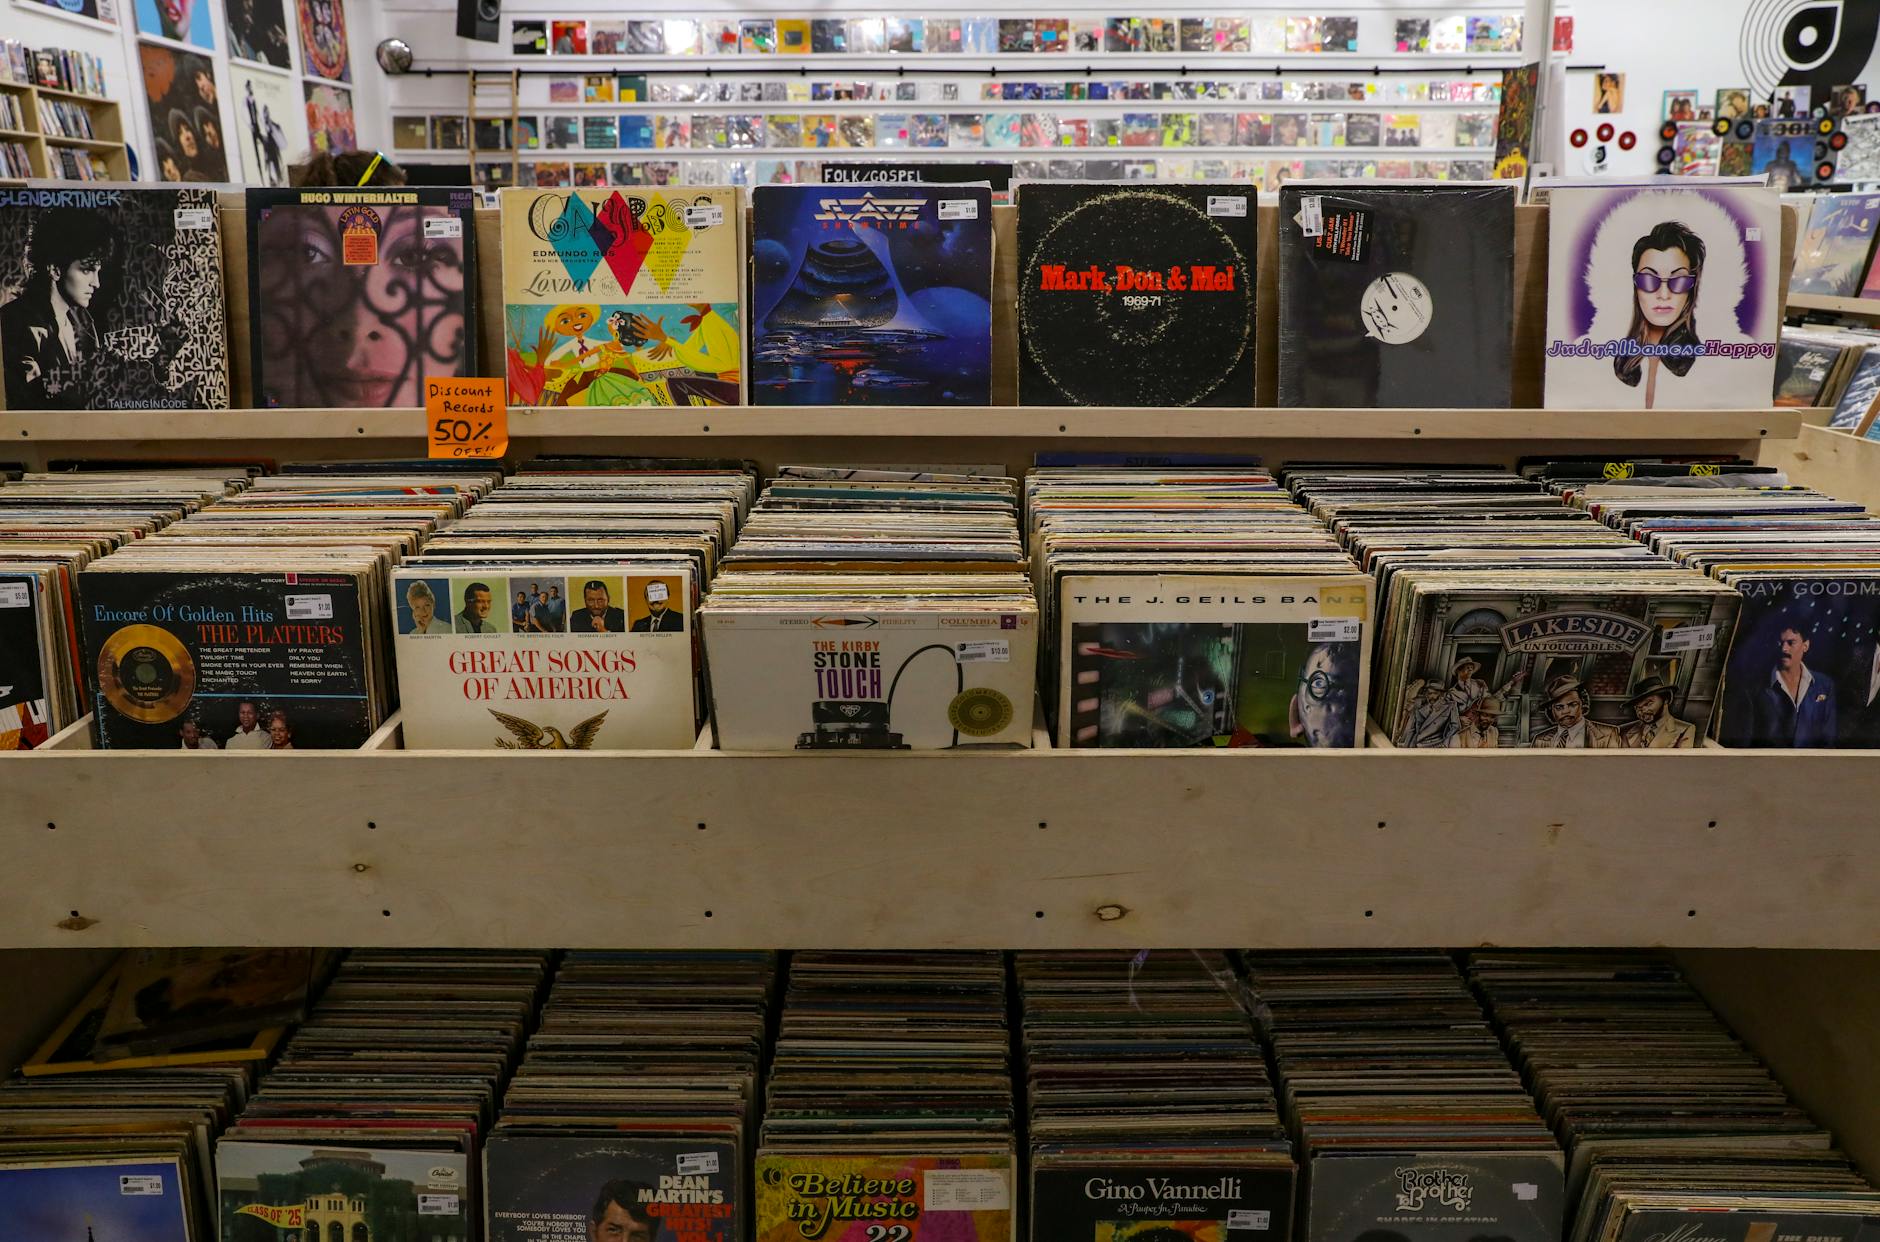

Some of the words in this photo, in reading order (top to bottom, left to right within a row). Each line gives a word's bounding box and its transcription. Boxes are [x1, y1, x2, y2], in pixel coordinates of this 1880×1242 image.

[824, 168, 923, 183] FOLK/GOSPEL
[300, 193, 332, 204] HUGO
[334, 193, 419, 204] WINTERHALTER
[814, 192, 928, 221] SLAVE
[341, 206, 361, 224] LATIN
[361, 207, 380, 224] GOLD
[822, 222, 920, 230] SHOWTIME
[523, 270, 597, 298] LONDON
[1040, 265, 1113, 294] Mark,
[1116, 266, 1162, 291] Don
[1167, 266, 1187, 291] &
[1190, 266, 1235, 291] Mel
[1122, 295, 1161, 307] 1969-71
[1704, 339, 1777, 359] Happy
[430, 384, 493, 399] Discount
[443, 401, 494, 412] Records
[434, 419, 493, 442] 50%
[1738, 583, 1780, 596] RAY
[1074, 596, 1131, 604] THE
[1146, 596, 1164, 604] J.
[1176, 596, 1266, 604] GEILS
[1280, 596, 1366, 604] BAND
[94, 605, 147, 622] Encore
[153, 604, 175, 622] Of
[179, 605, 235, 622] Golden
[241, 605, 273, 622] Hits
[197, 624, 240, 644] THE
[247, 624, 345, 644] PLATTERS
[1511, 617, 1641, 645] LAKESIDE
[812, 641, 837, 651] THE
[842, 641, 880, 651] KIRBY
[1524, 643, 1624, 651] UNTOUCHABLES
[448, 650, 539, 674] GREAT
[548, 649, 636, 672] SONGS
[814, 652, 881, 669] STONE
[463, 678, 500, 701] OF
[505, 677, 631, 700] AMERICA
[814, 669, 882, 699] TOUCH
[659, 1176, 709, 1190] DEAN
[788, 1173, 915, 1196] Believe
[1084, 1177, 1145, 1200] Gino
[1146, 1177, 1242, 1200] Vannelli
[1395, 1167, 1469, 1194] Brother
[637, 1189, 724, 1204] MARTIN'S
[247, 1206, 269, 1218] CLASS
[271, 1209, 282, 1223] OF
[646, 1203, 733, 1217] GREATEST
[787, 1198, 818, 1218] in
[799, 1196, 918, 1237] Music
[1126, 1203, 1157, 1216] Pauper
[1171, 1203, 1208, 1216] Paradise
[865, 1224, 910, 1242] 22
